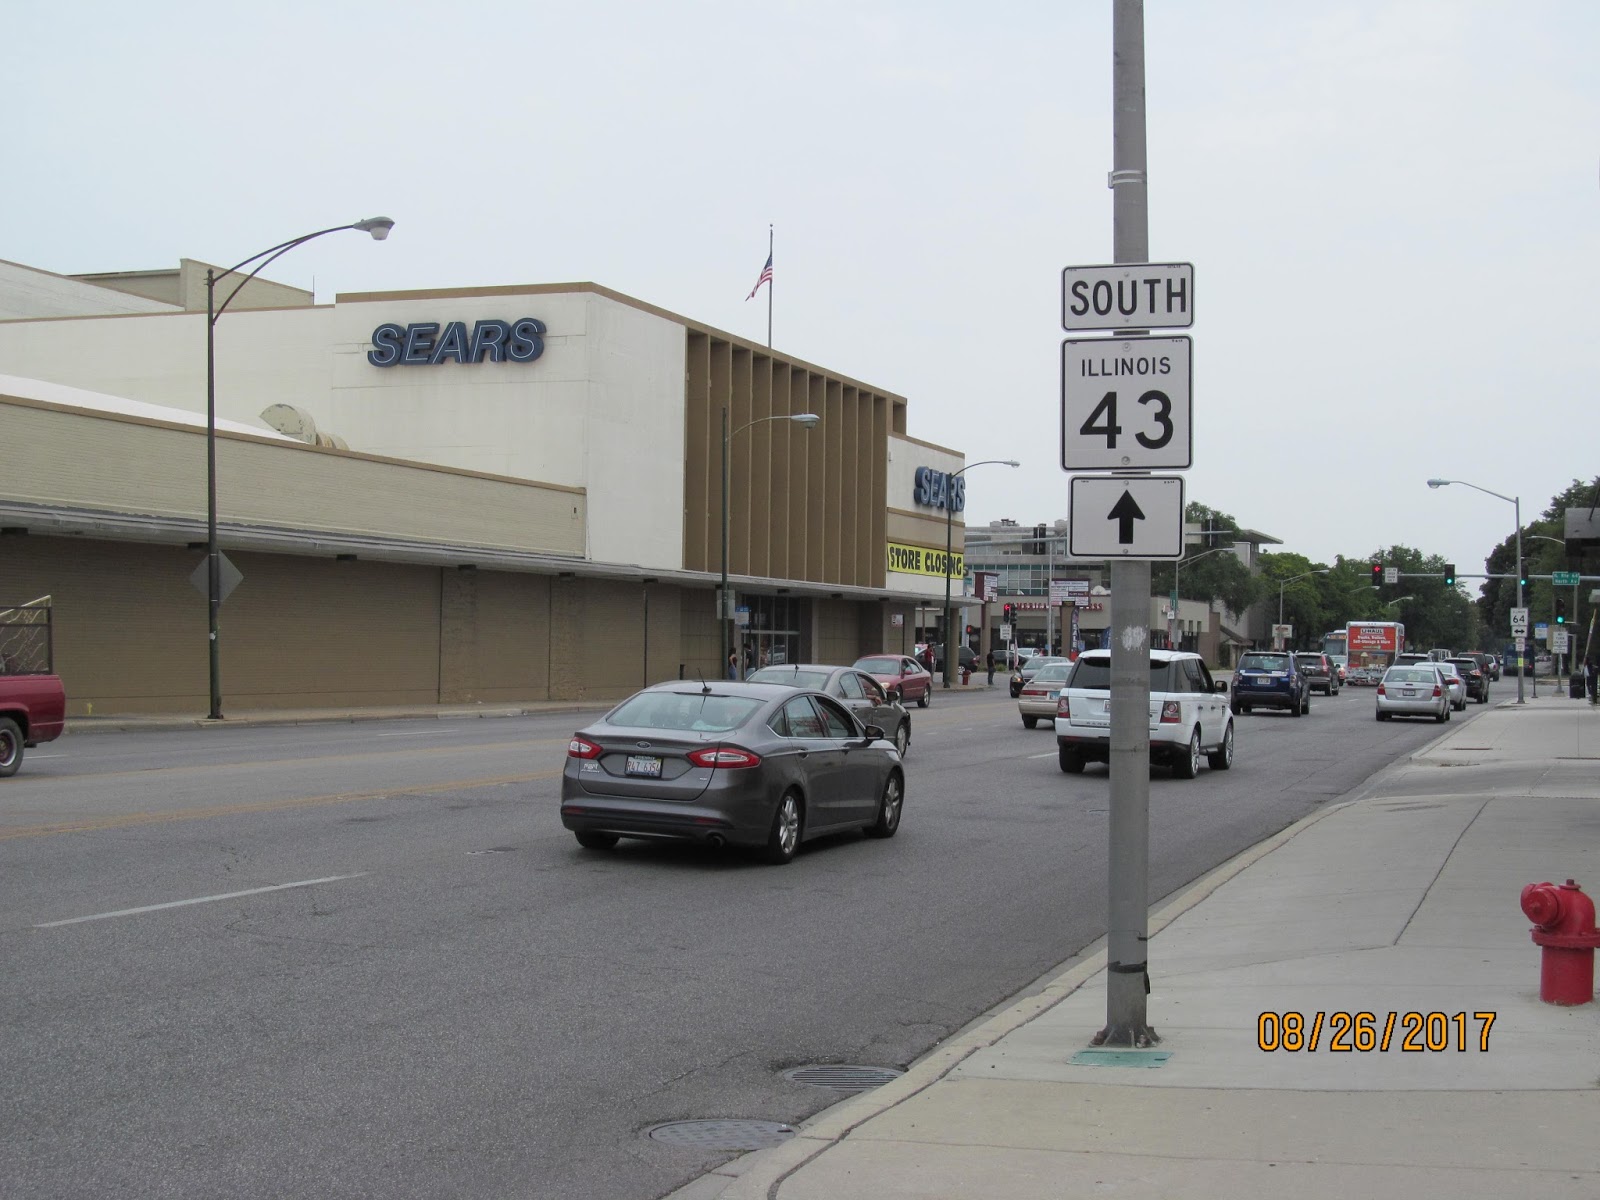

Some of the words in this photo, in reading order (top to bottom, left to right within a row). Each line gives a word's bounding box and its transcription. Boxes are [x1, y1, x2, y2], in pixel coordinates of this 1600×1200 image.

[1070, 278, 1186, 316] SOUTH
[367, 318, 547, 367] SEARS
[1081, 356, 1171, 377] ILLINOIS
[1079, 390, 1174, 450] 43
[914, 466, 965, 512] SEARS
[890, 547, 921, 570] STORE
[925, 552, 962, 575] CLOSNG
[1513, 615, 1525, 623] 64
